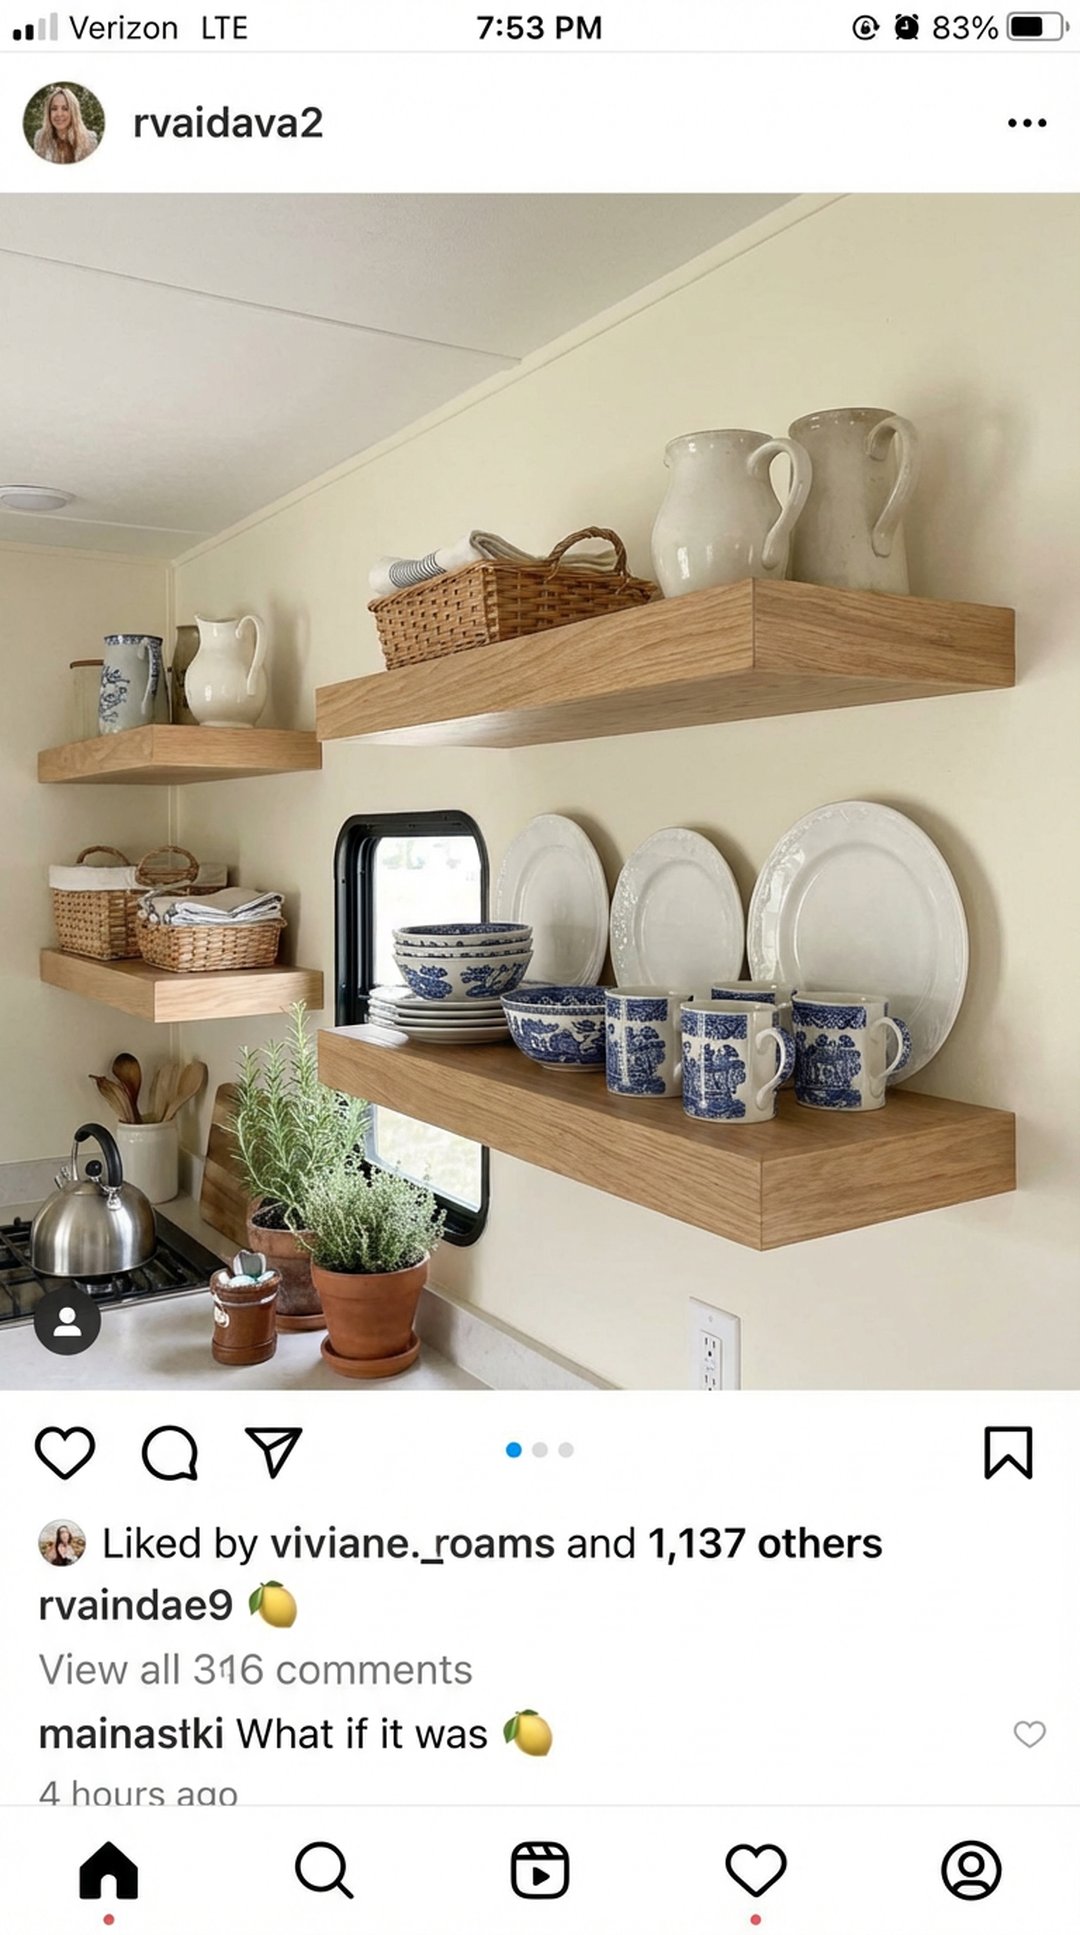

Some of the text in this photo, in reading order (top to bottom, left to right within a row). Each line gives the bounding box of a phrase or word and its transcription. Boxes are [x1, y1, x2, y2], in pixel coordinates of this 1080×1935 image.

[69, 15, 248, 41] Verizon LTE
[476, 15, 602, 41] 7:53 PM
[933, 15, 1000, 41] 83%
[134, 105, 324, 139] rvaidava2
[103, 1525, 883, 1566] Liked by viviane._roams and 1,137 others
[40, 1587, 233, 1620] rvaindae9
[38, 1653, 129, 1685] View
[141, 1653, 179, 1685] all
[277, 1655, 473, 1685] comments
[40, 1716, 488, 1750] mainastki What if it was
[39, 1780, 61, 1806] 4
[72, 1779, 165, 1806] hours
